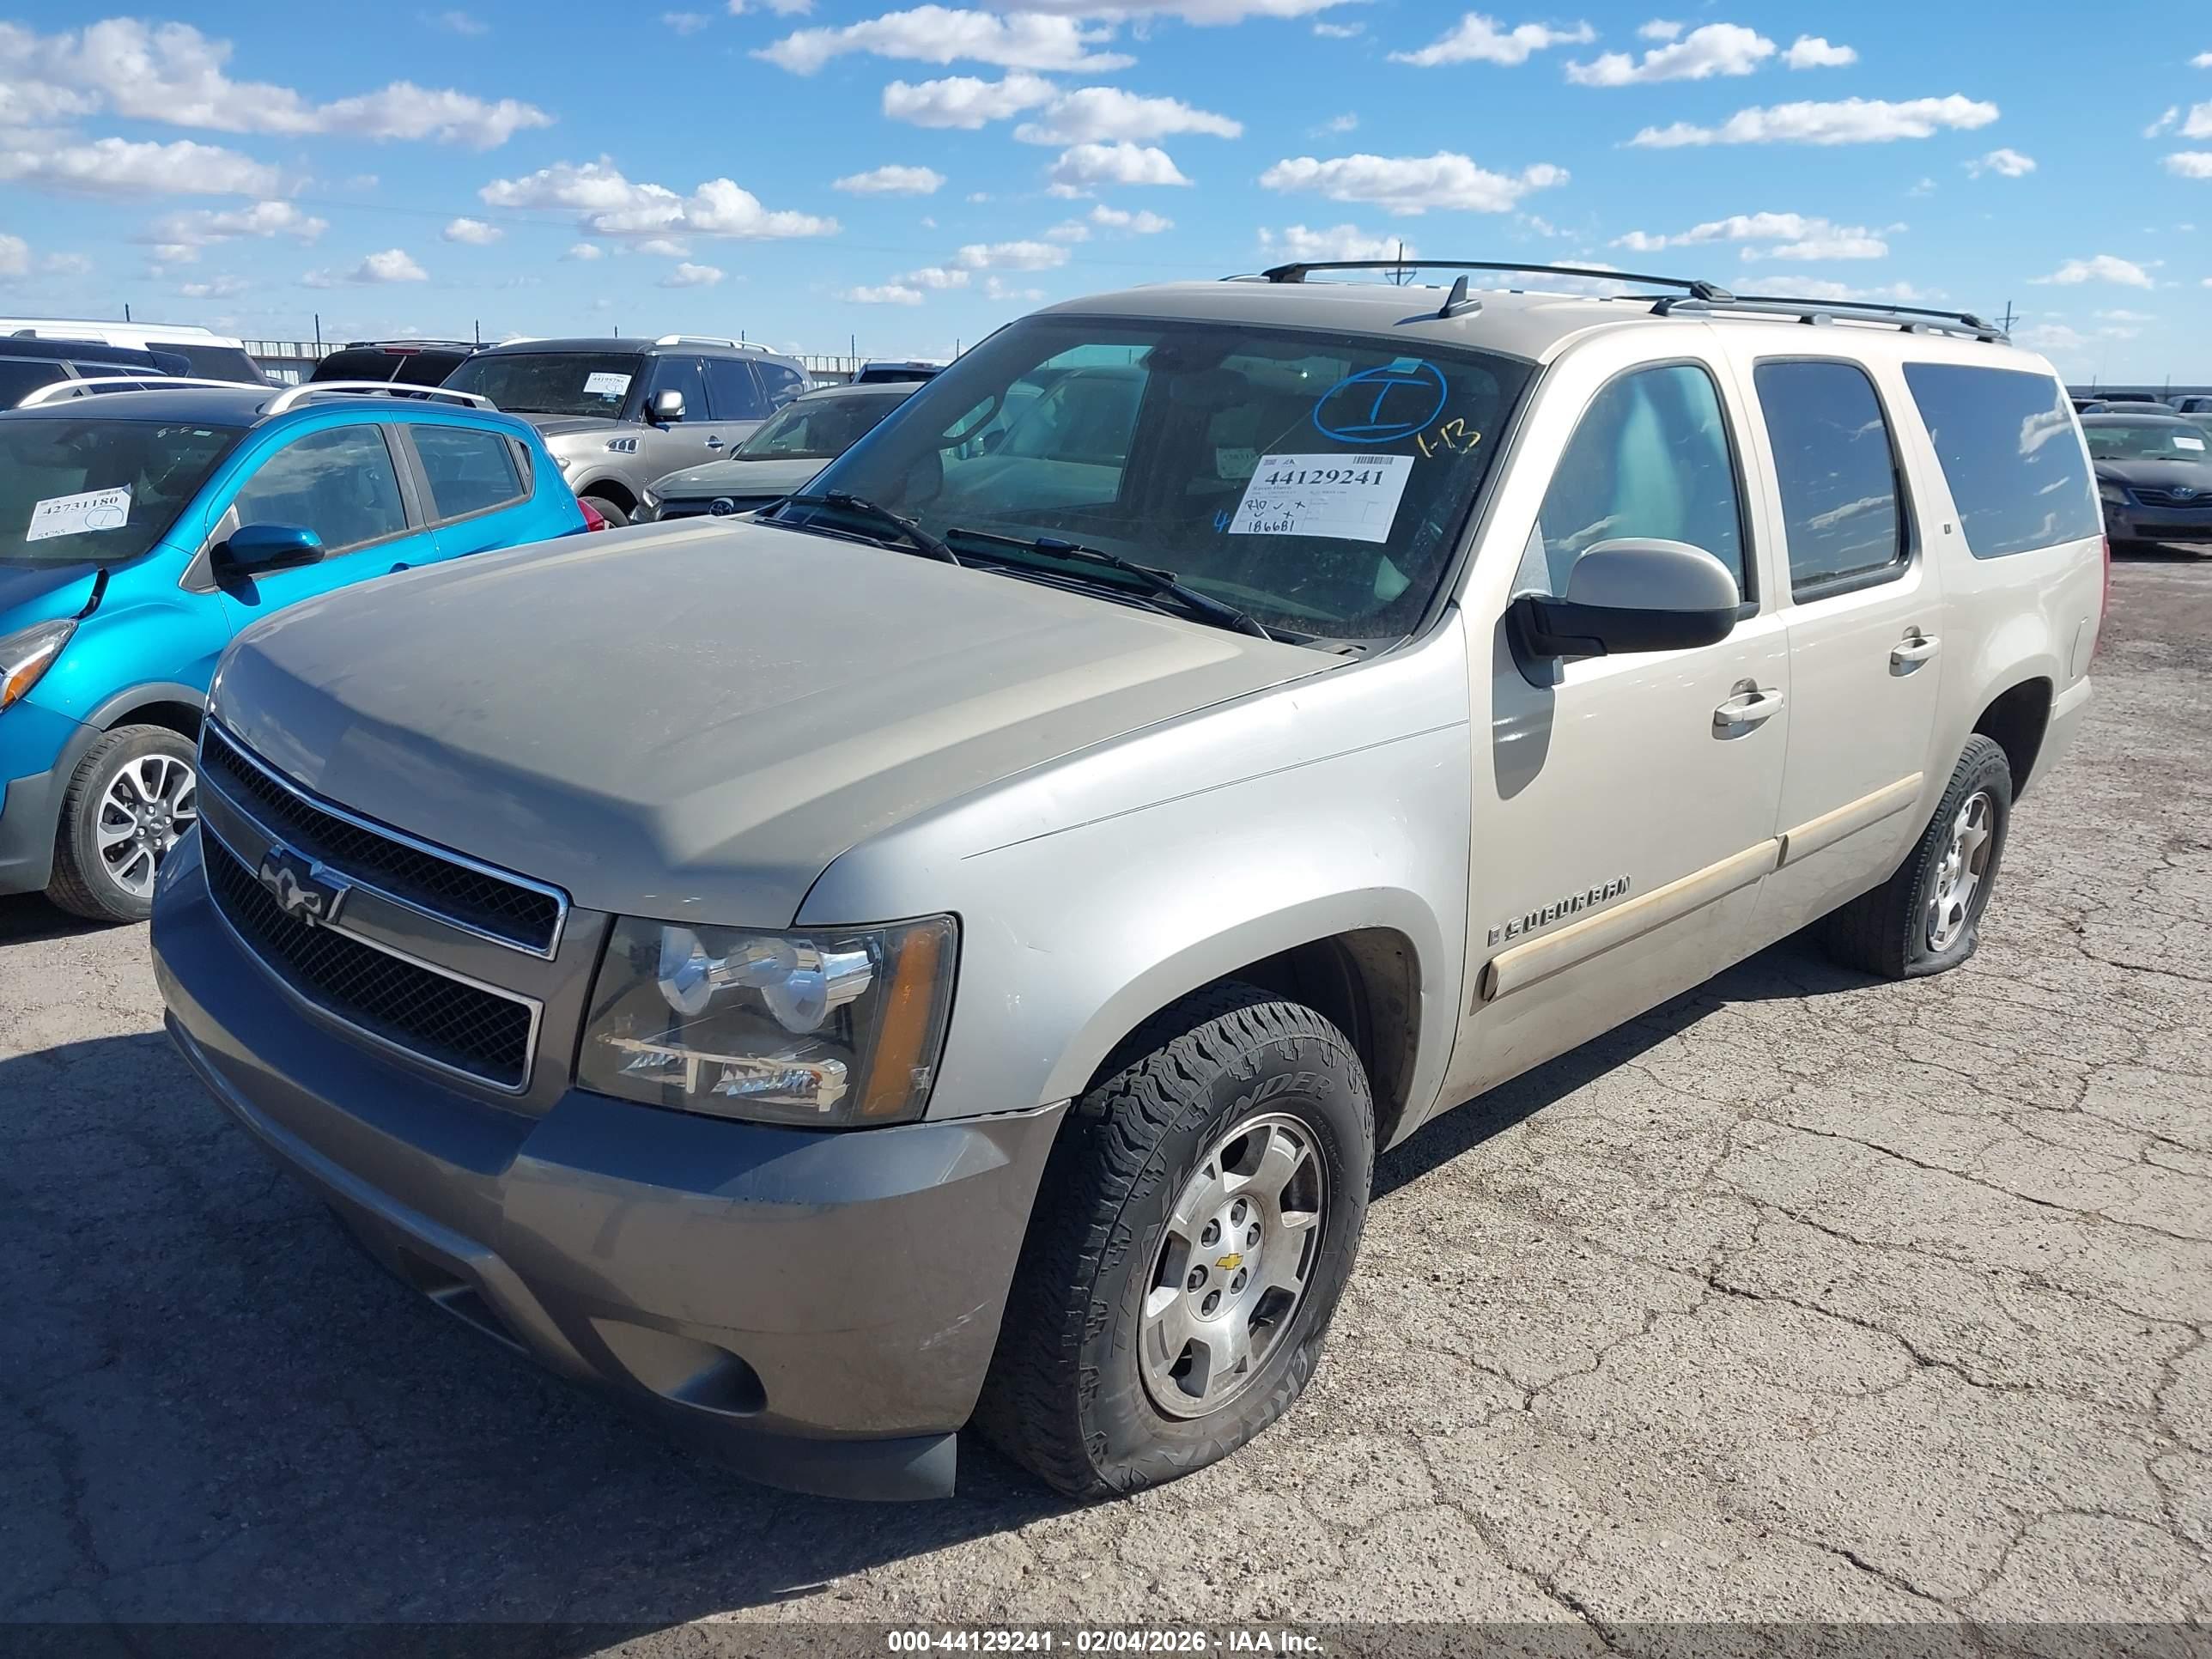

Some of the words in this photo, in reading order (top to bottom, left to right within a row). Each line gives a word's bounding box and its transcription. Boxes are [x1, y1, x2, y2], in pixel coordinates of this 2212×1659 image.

[1265, 469, 1385, 486] 44129241
[43, 496, 118, 515] 42731180
[1248, 520, 1295, 533] 186681
[1504, 873, 1632, 942] SUBURBAN
